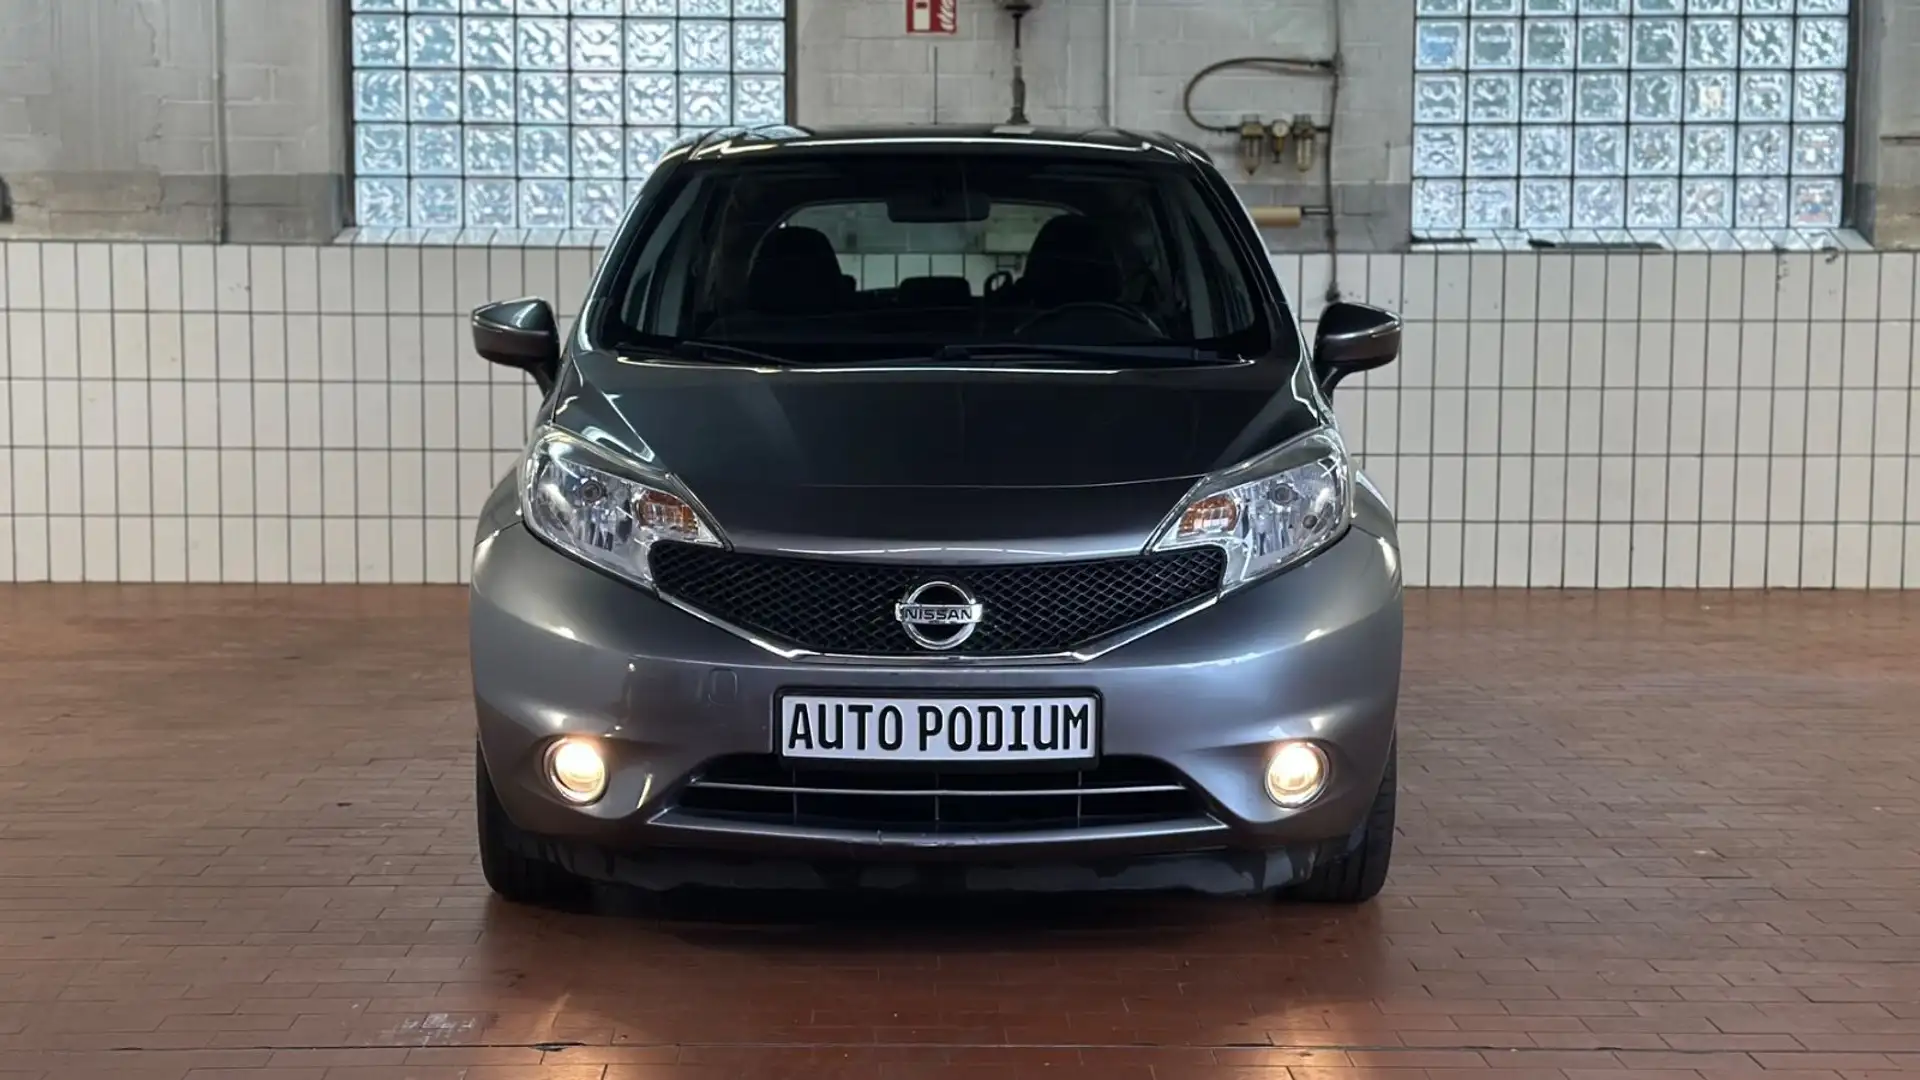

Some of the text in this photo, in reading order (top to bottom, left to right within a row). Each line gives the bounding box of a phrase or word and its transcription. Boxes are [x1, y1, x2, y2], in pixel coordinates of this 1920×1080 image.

[904, 608, 973, 621] NISSAN
[788, 703, 1089, 752] AUTO PODIUM
